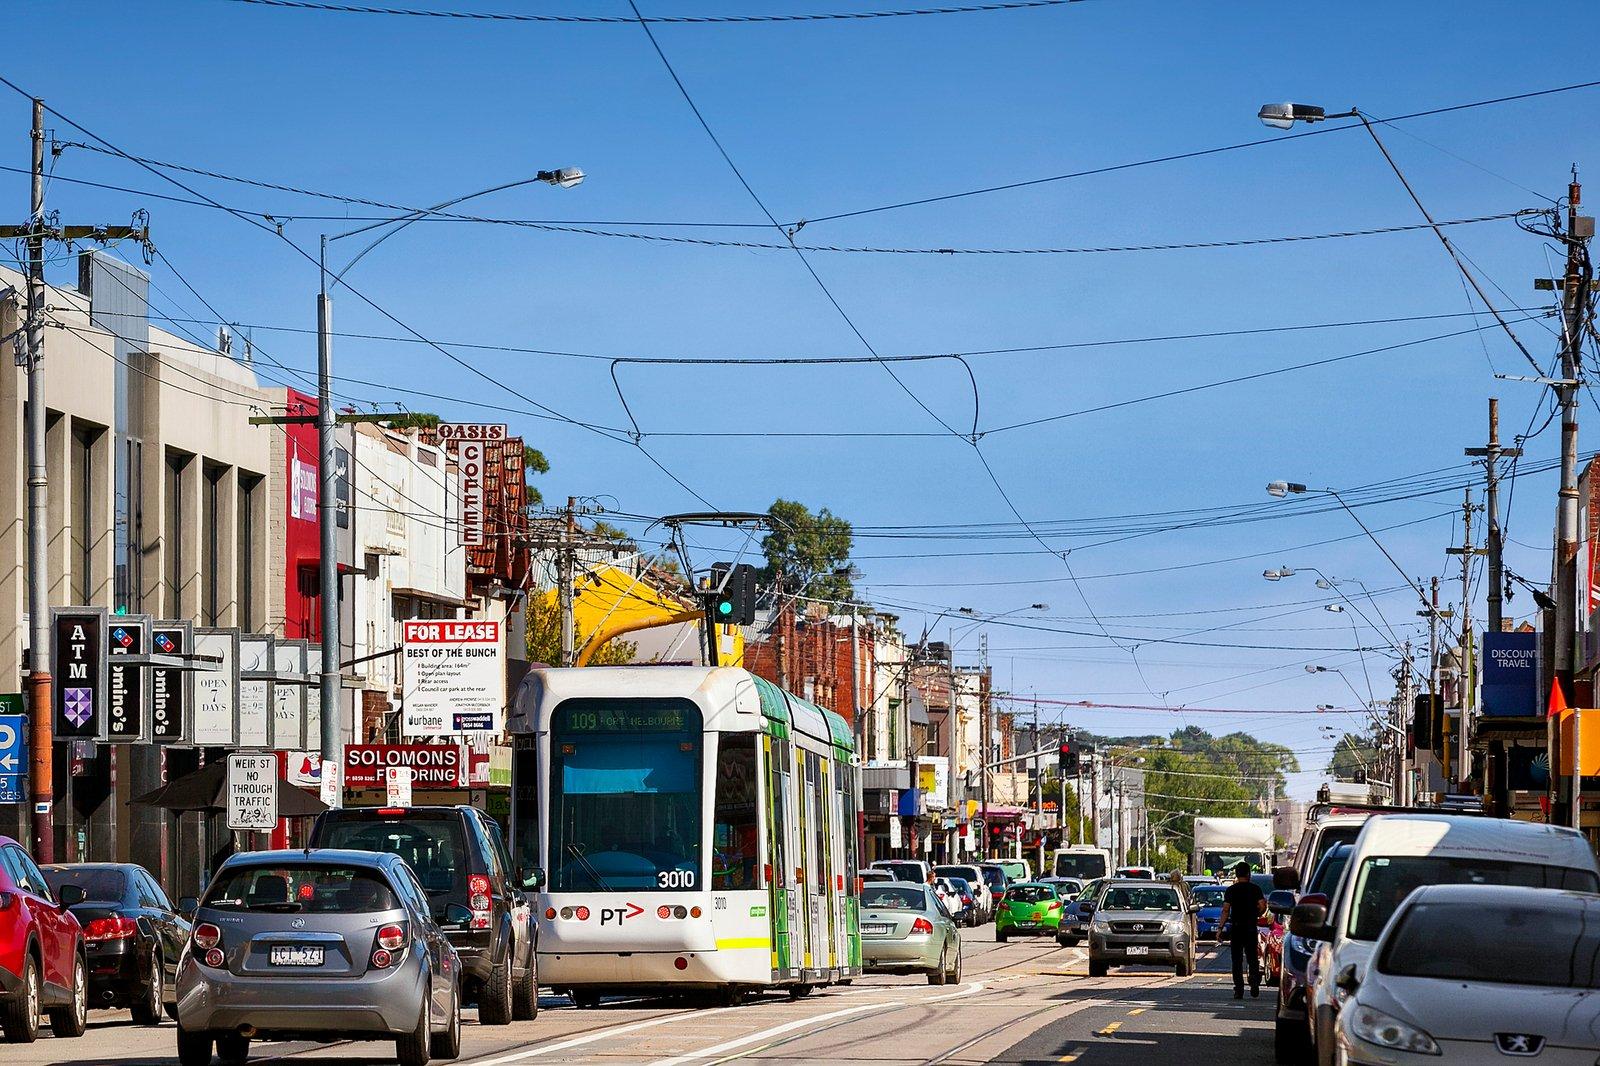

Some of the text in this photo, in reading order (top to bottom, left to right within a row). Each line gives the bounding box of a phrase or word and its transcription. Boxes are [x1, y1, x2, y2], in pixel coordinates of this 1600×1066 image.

[438, 425, 503, 439] OASIS
[464, 446, 479, 542] COFFEE
[407, 625, 496, 641] FOR LEASE
[69, 624, 89, 679] ATM
[407, 648, 496, 658] BEST OF THE BUNCH
[1497, 659, 1531, 668] TRAVEL
[200, 679, 228, 688] OPEN
[211, 689, 218, 702] 7
[155, 670, 169, 736] omino's
[202, 704, 227, 712] DAYS
[279, 697, 286, 710] 7
[413, 715, 443, 726] urbane
[571, 712, 597, 729] 109
[234, 759, 270, 769] WEIR ST
[349, 750, 457, 766] SOLOMONS
[246, 771, 259, 781] NO
[376, 769, 456, 781] FORING
[232, 784, 273, 794] THROUGH
[234, 796, 271, 807] TRAFFIC
[658, 870, 695, 888] 3010
[714, 897, 727, 910] 3010
